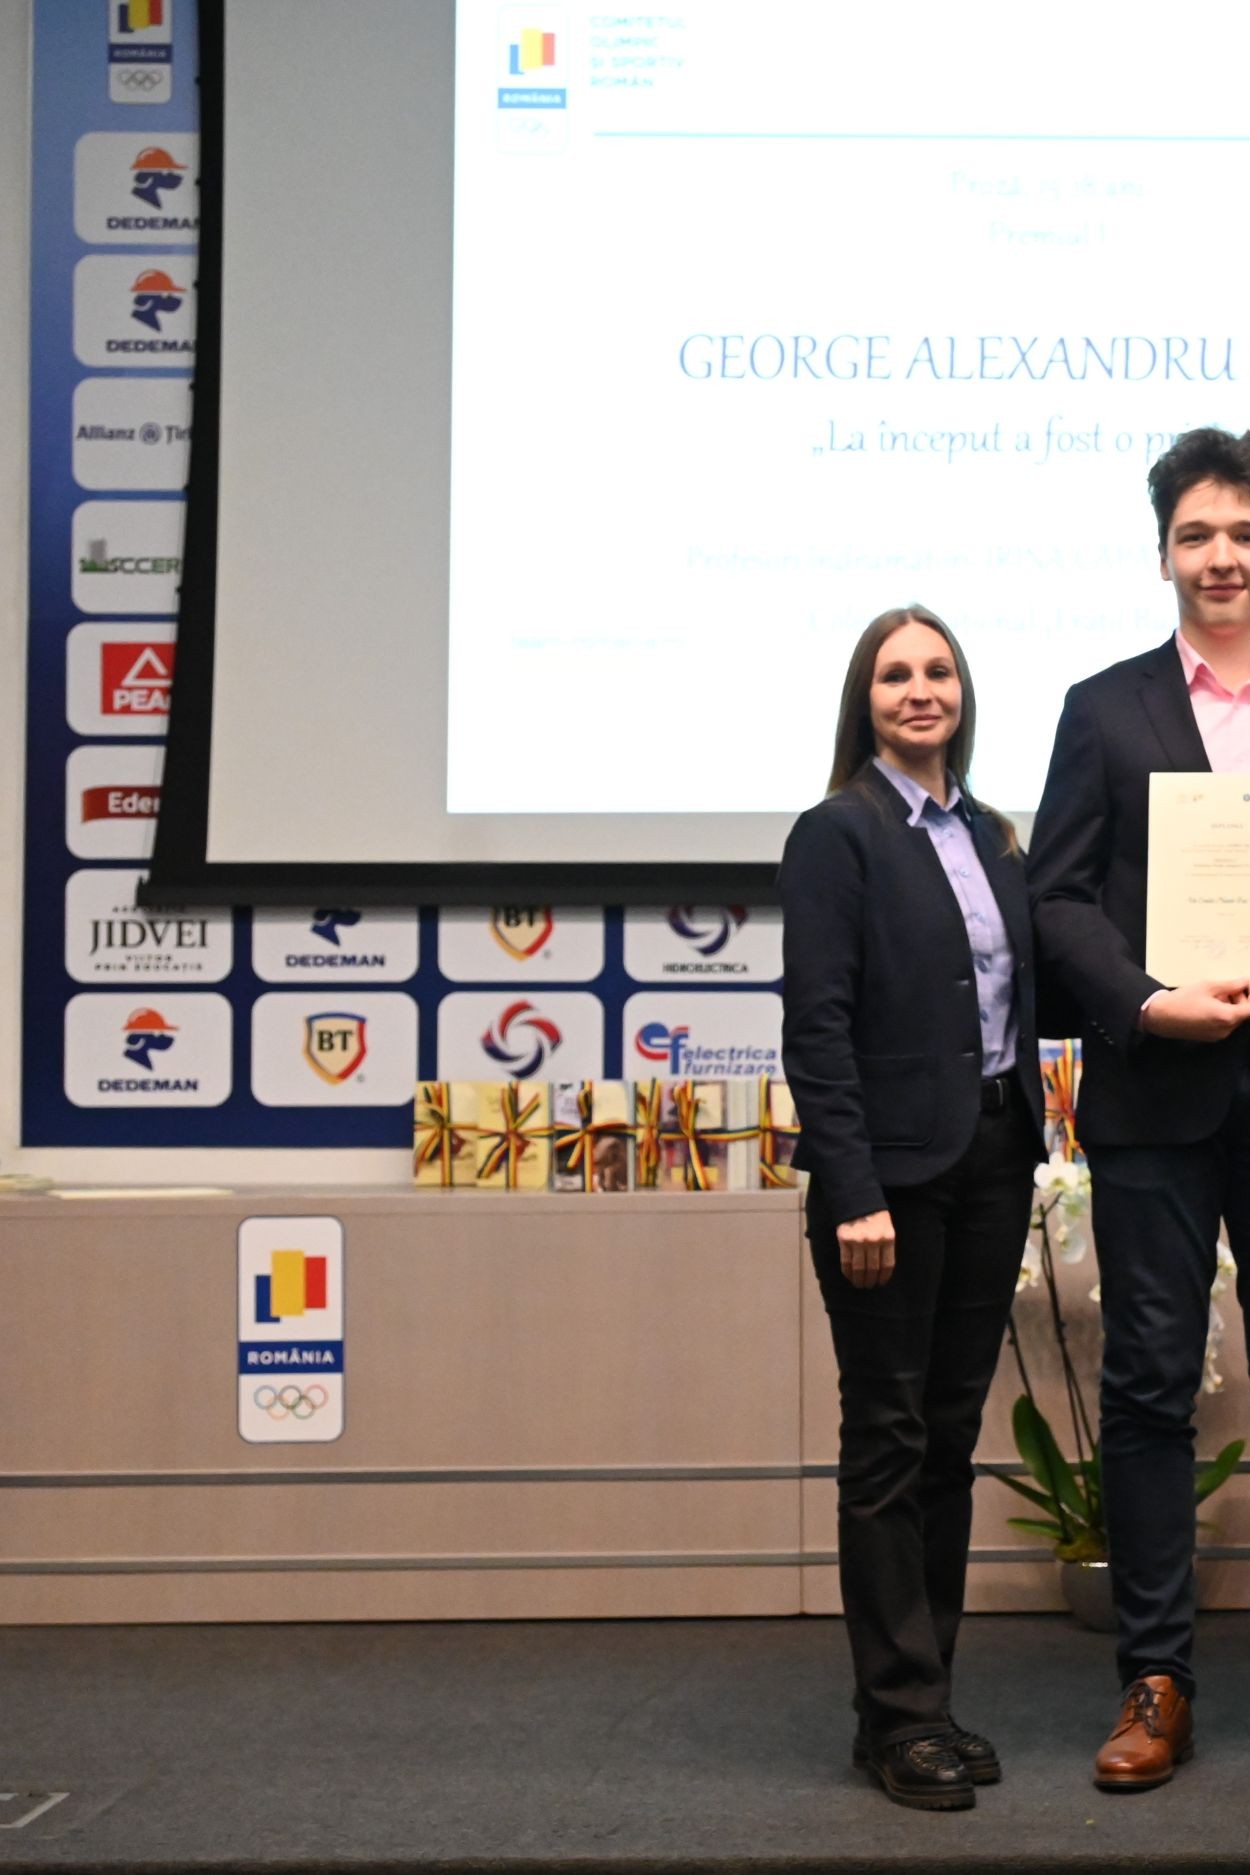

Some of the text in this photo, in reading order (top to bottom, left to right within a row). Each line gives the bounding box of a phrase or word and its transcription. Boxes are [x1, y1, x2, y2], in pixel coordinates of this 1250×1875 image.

[106, 340, 196, 352] DEDEMA
[678, 334, 892, 380] GEORGE
[905, 335, 1235, 381] ALEXANDRU
[77, 425, 135, 440] Allianz
[879, 416, 1002, 466] început
[1014, 432, 1034, 453] a
[1034, 415, 1102, 466] fost
[1114, 432, 1133, 453] o
[112, 689, 171, 712] PEA
[90, 918, 209, 956] JIDVEI
[285, 954, 385, 968] DEDEMAN
[662, 962, 748, 974] HIDROELECTRICA
[316, 1029, 354, 1052] BT
[682, 1046, 777, 1061] electrica
[97, 1078, 199, 1092] DEDEMAN
[247, 1347, 335, 1365] ROMÂNIA
